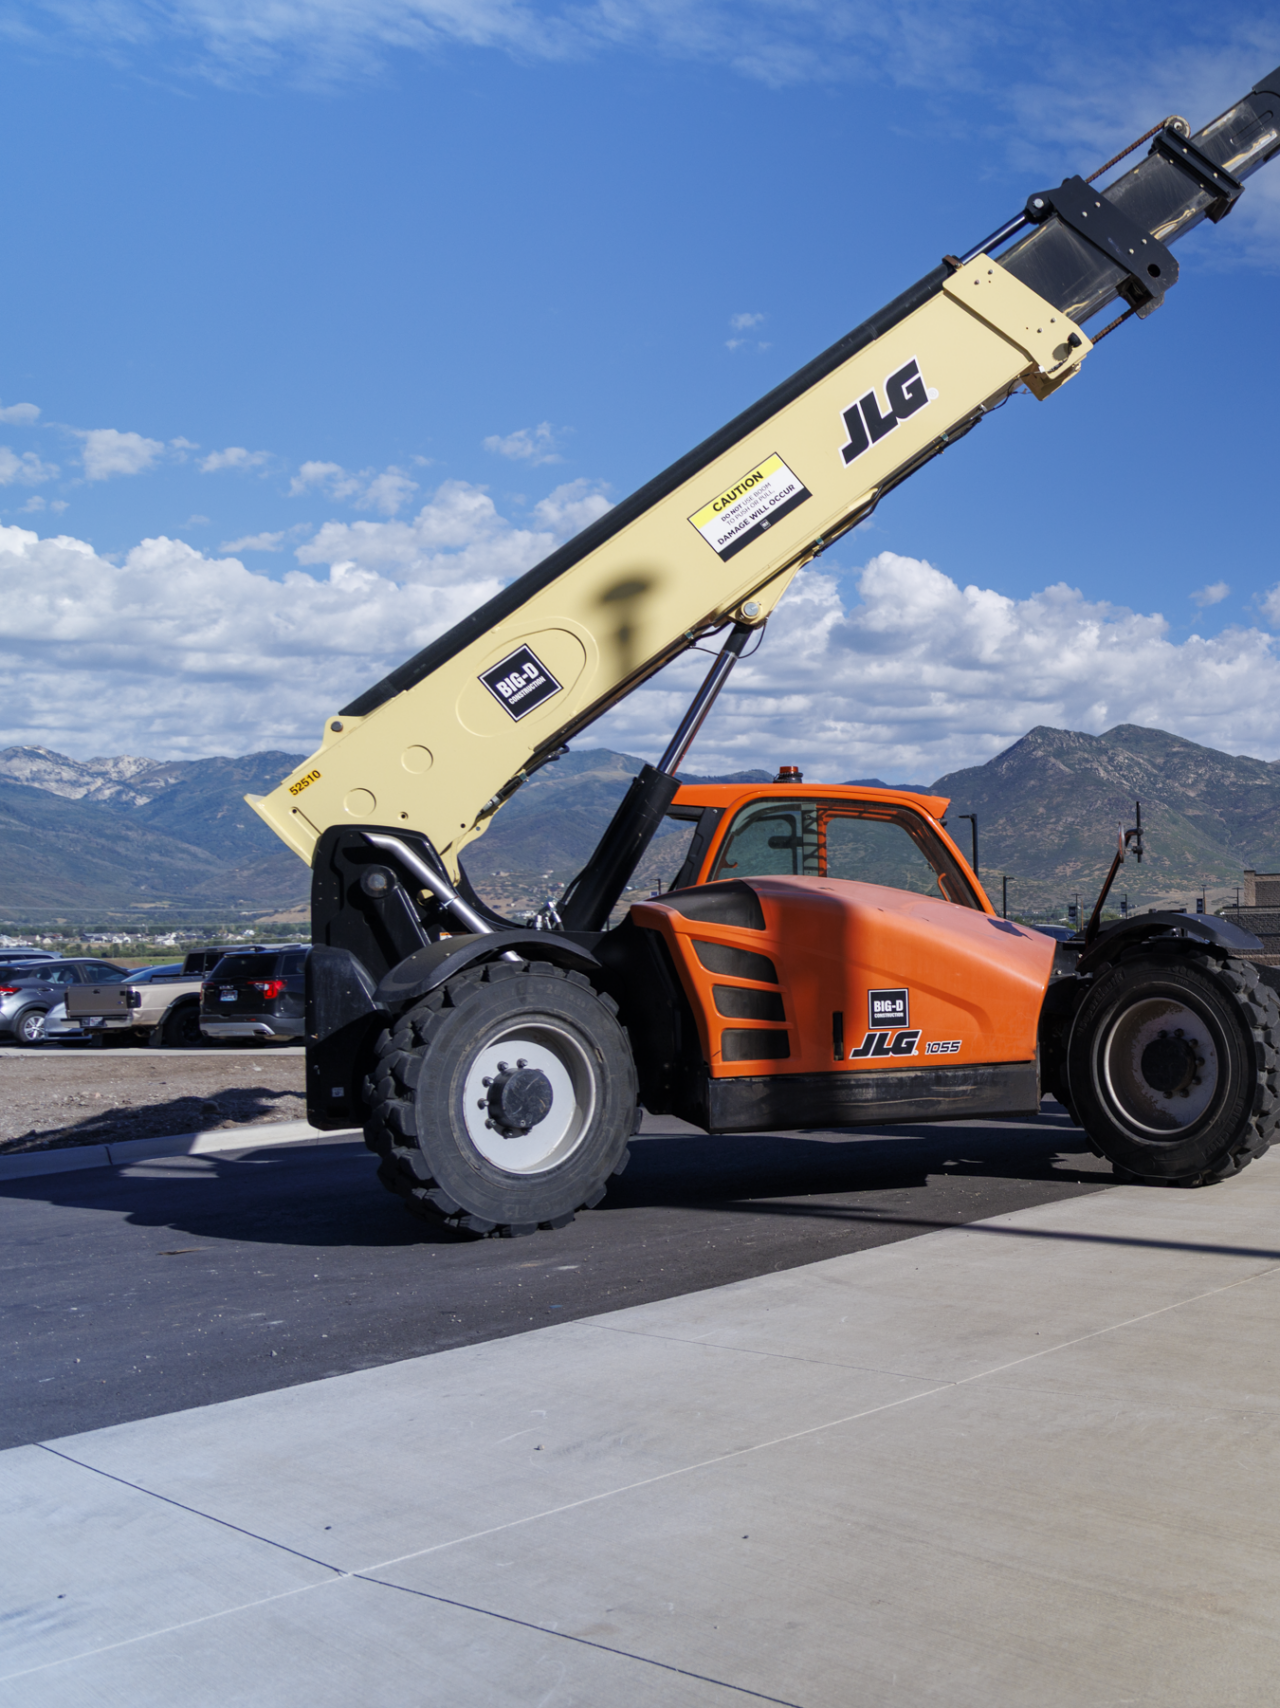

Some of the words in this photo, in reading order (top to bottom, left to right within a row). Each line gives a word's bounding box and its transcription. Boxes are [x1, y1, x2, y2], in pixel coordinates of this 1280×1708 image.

[840, 356, 930, 467] JLG
[712, 470, 764, 512] CAUTION
[721, 512, 731, 522] DO
[730, 504, 743, 516] NOT
[742, 495, 754, 507] USE
[753, 482, 772, 498] BOOM
[717, 518, 751, 545] DAMAGE
[748, 504, 770, 521] WILL
[768, 484, 796, 506] OCCUR
[726, 517, 736, 526] TO
[734, 506, 751, 520] PUSH
[750, 499, 760, 510] OR
[495, 662, 540, 698] BIG-D
[508, 675, 547, 705] CONSTRUCTION
[289, 770, 321, 796] 52510
[873, 1000, 904, 1012] BIG-D
[850, 1030, 921, 1058] JLG
[925, 1040, 962, 1054] 1055
